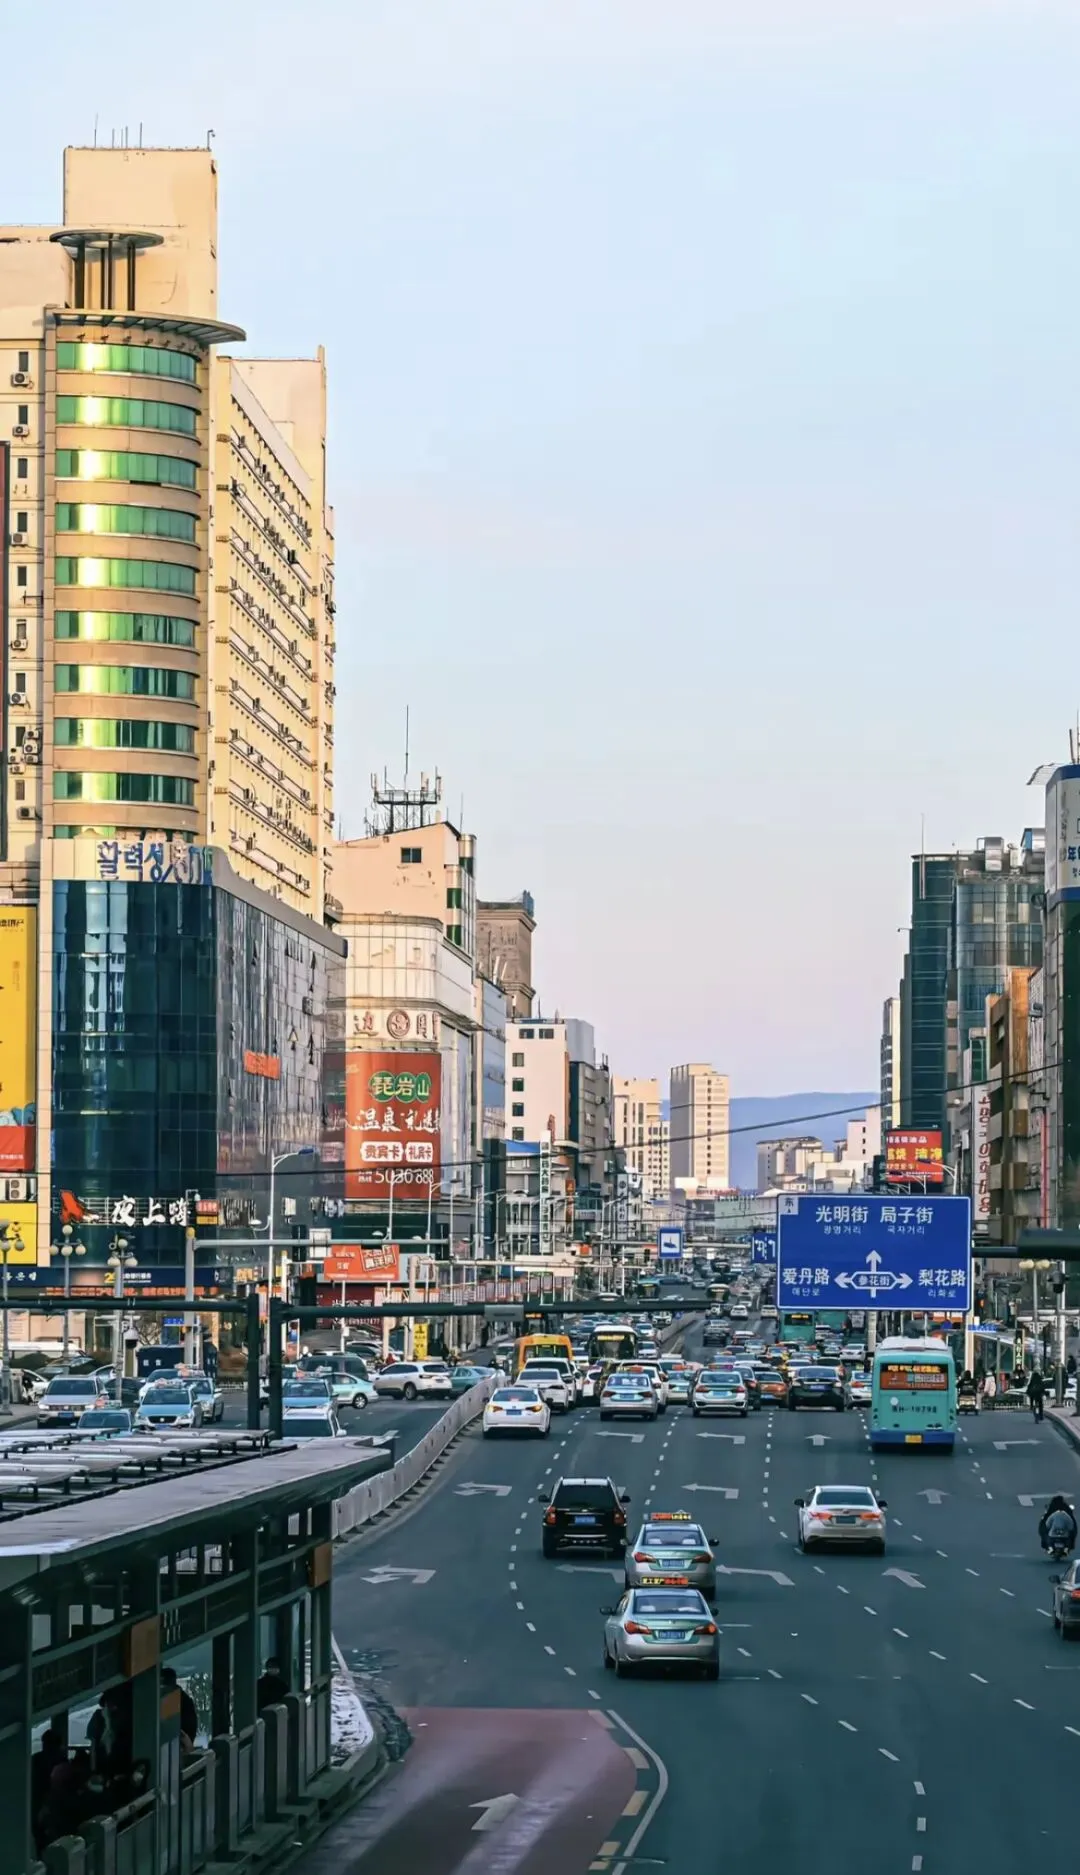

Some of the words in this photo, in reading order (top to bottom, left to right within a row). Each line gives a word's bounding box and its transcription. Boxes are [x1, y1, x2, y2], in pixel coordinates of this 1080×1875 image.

[371, 1075, 430, 1097] 琵岩山
[365, 1144, 401, 1160] 贵宾卡
[815, 1205, 869, 1224] 光明街
[879, 1206, 934, 1224] 局子街
[823, 1225, 862, 1235] 광명거리
[887, 1225, 925, 1235] 국자거리
[782, 1268, 830, 1286] 爱丹路
[858, 1275, 890, 1287] 参花街
[918, 1269, 966, 1287] 梨花路
[928, 1289, 956, 1298] 리화로
